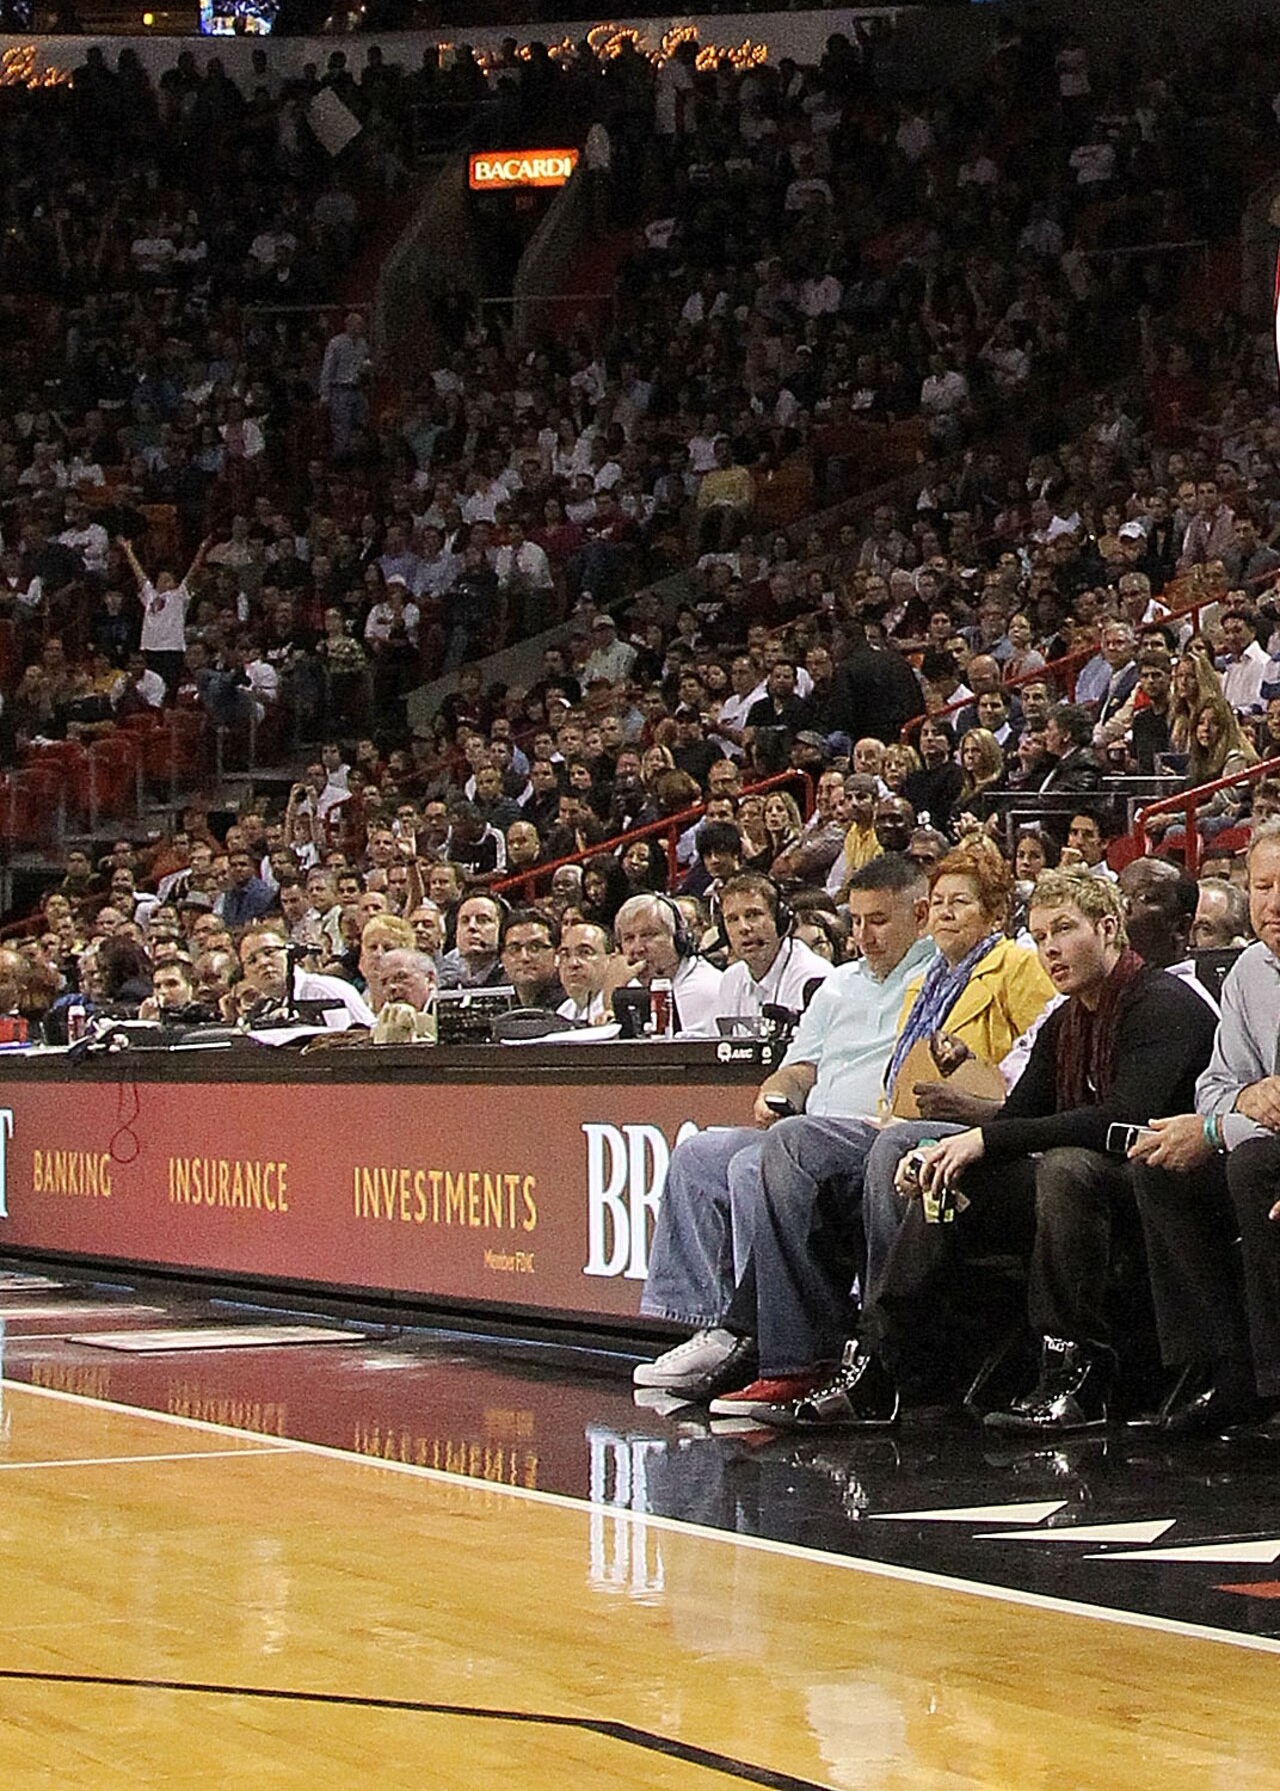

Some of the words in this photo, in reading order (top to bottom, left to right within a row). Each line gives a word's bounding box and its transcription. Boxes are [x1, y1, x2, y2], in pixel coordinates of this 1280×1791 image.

[474, 157, 571, 181] BACARDI
[33, 1149, 112, 1198] BANKING
[169, 1157, 289, 1213] INSURANCE
[353, 1166, 538, 1232] INVESTMENTS
